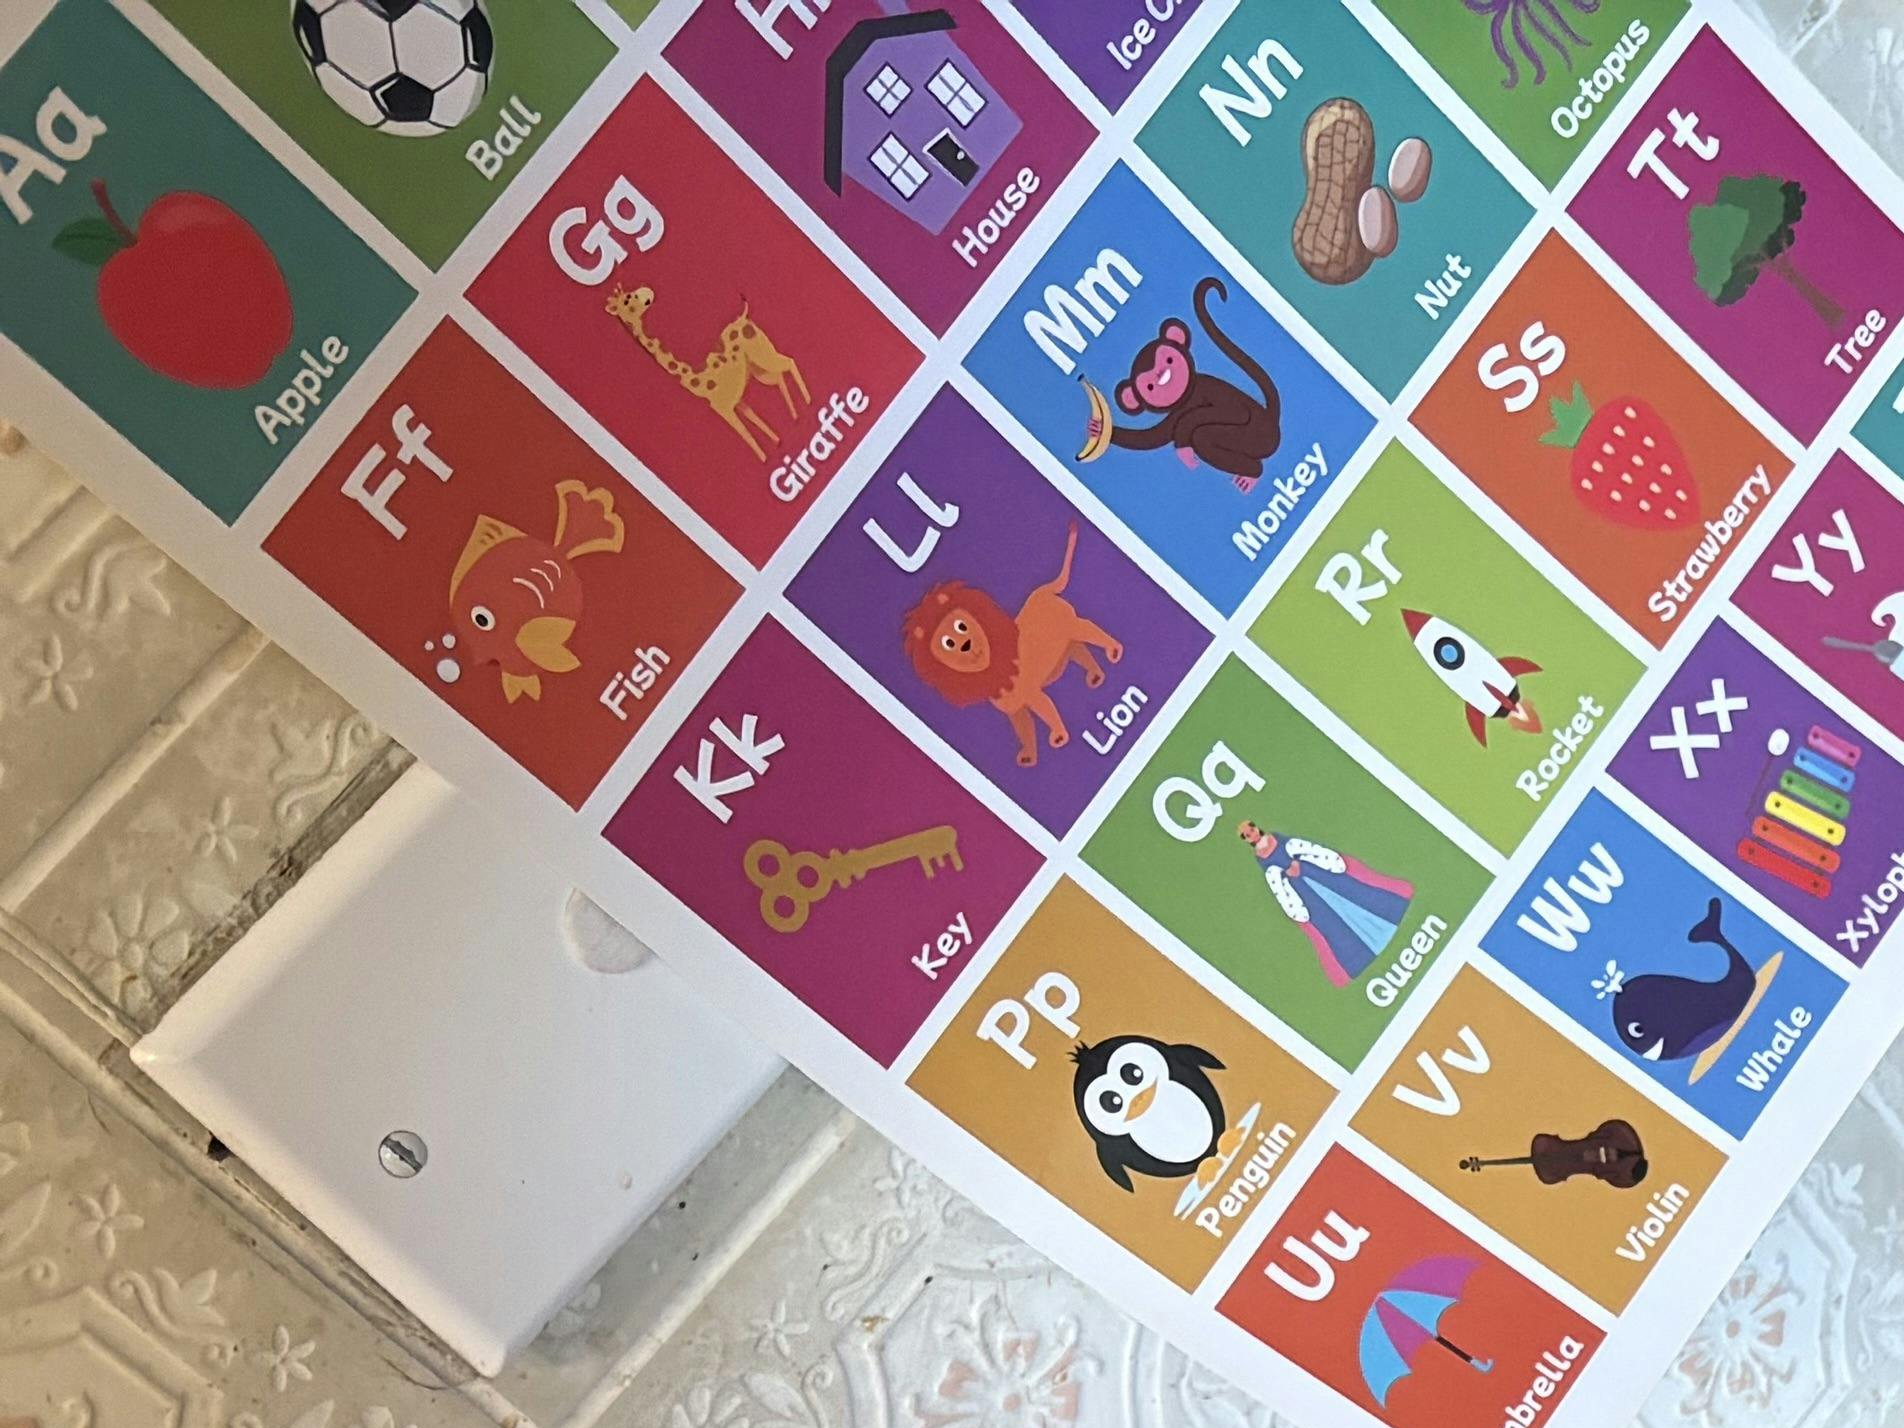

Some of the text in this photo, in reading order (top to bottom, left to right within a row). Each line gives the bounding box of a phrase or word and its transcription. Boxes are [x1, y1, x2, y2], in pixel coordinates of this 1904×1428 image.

[735, 0, 831, 59] H
[1107, 19, 1155, 70] Ice
[1199, 39, 1303, 146] Nn
[1551, 20, 1649, 138] Octopus
[0, 87, 107, 224] Aa
[466, 96, 541, 180] Ball
[1627, 108, 1719, 199] Tt
[549, 175, 664, 285] Gg
[953, 168, 1039, 267] House
[1024, 249, 1142, 374] Mm
[1415, 255, 1471, 319] Nut
[255, 336, 348, 444] Apple
[1478, 321, 1565, 412] Ss
[1825, 310, 1886, 373] Tree
[341, 404, 453, 540] Ff
[770, 387, 869, 501] Giraffe
[863, 472, 959, 572] Ll
[1233, 443, 1327, 561] Monkey
[1648, 465, 1770, 621] Strawberry
[1315, 529, 1402, 625] Rr
[1772, 510, 1864, 596] Yy
[600, 647, 670, 720] Fish
[1083, 686, 1148, 754] Lion
[1650, 679, 1748, 778] Xx
[674, 714, 785, 823] Kk
[1153, 741, 1266, 842] Qq
[1510, 696, 1604, 801] Rocket
[912, 912, 972, 980] Key
[1517, 843, 1623, 951] Ww
[1366, 915, 1447, 1007] Queen
[977, 972, 1080, 1069] Pp
[1736, 1007, 1811, 1091] Whale
[1392, 1026, 1490, 1115] Vv
[1196, 1123, 1296, 1237] Penguin
[1616, 1184, 1689, 1261] Violin
[1264, 1211, 1370, 1301] Uu
